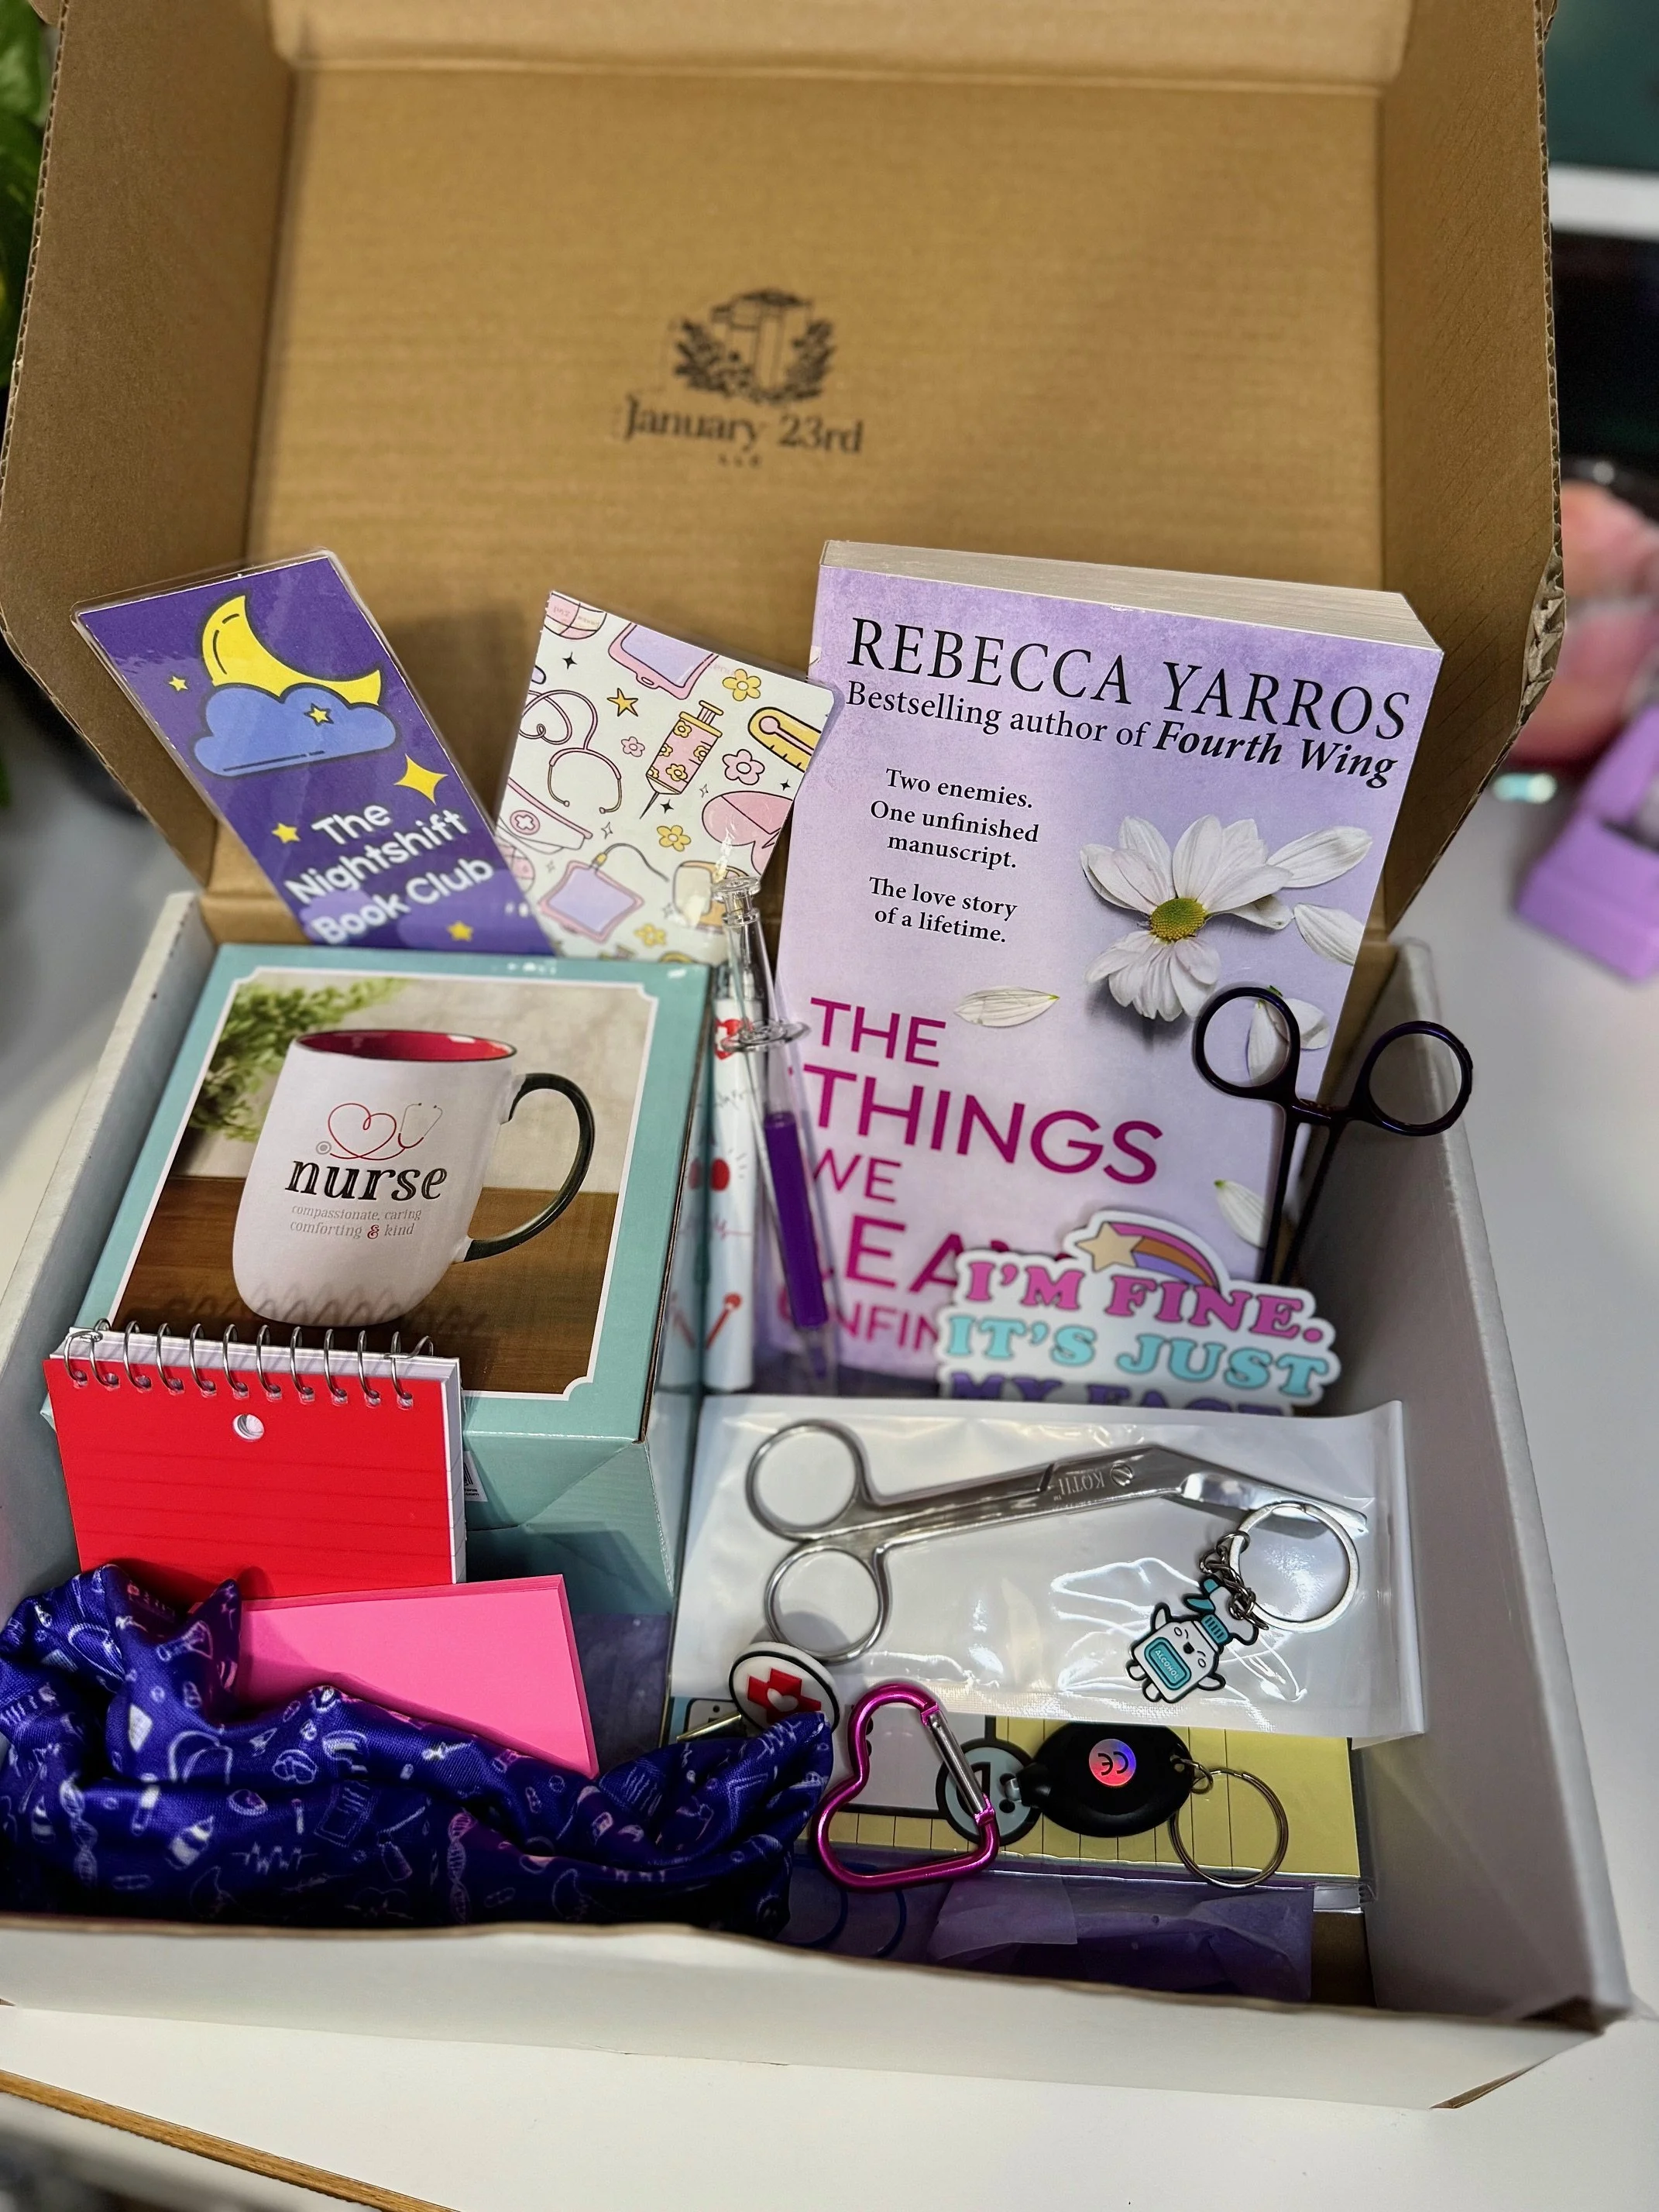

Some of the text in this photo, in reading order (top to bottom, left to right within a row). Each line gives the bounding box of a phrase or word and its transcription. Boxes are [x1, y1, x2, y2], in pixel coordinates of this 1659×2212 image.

[623, 393, 864, 454] January 23rd
[846, 617, 1410, 740] REBECCA YARROS
[846, 681, 1399, 788] Bestselling author of Fourth Wing
[885, 768, 1032, 809] Two enemies.
[311, 805, 391, 845] The
[870, 799, 1039, 843] One unfinished
[285, 810, 469, 905] Nightshift
[888, 836, 1017, 869] manuscript.
[310, 858, 493, 945] Book Club
[869, 877, 1018, 921] The love story
[874, 904, 1006, 943] of a lifetime.
[810, 998, 946, 1067] THE
[802, 1063, 1164, 1183] THINGS
[285, 1160, 447, 1201] nurse
[812, 1148, 902, 1204] WE
[290, 1220, 414, 1239] comforting & kind
[384, 1208, 421, 1221] caring
[965, 1261, 1323, 1343] I'M FINE.
[946, 1315, 1097, 1366] IT'S
[1116, 1334, 1330, 1396] JUST
[1155, 1649, 1180, 1679] ALCOHOL
